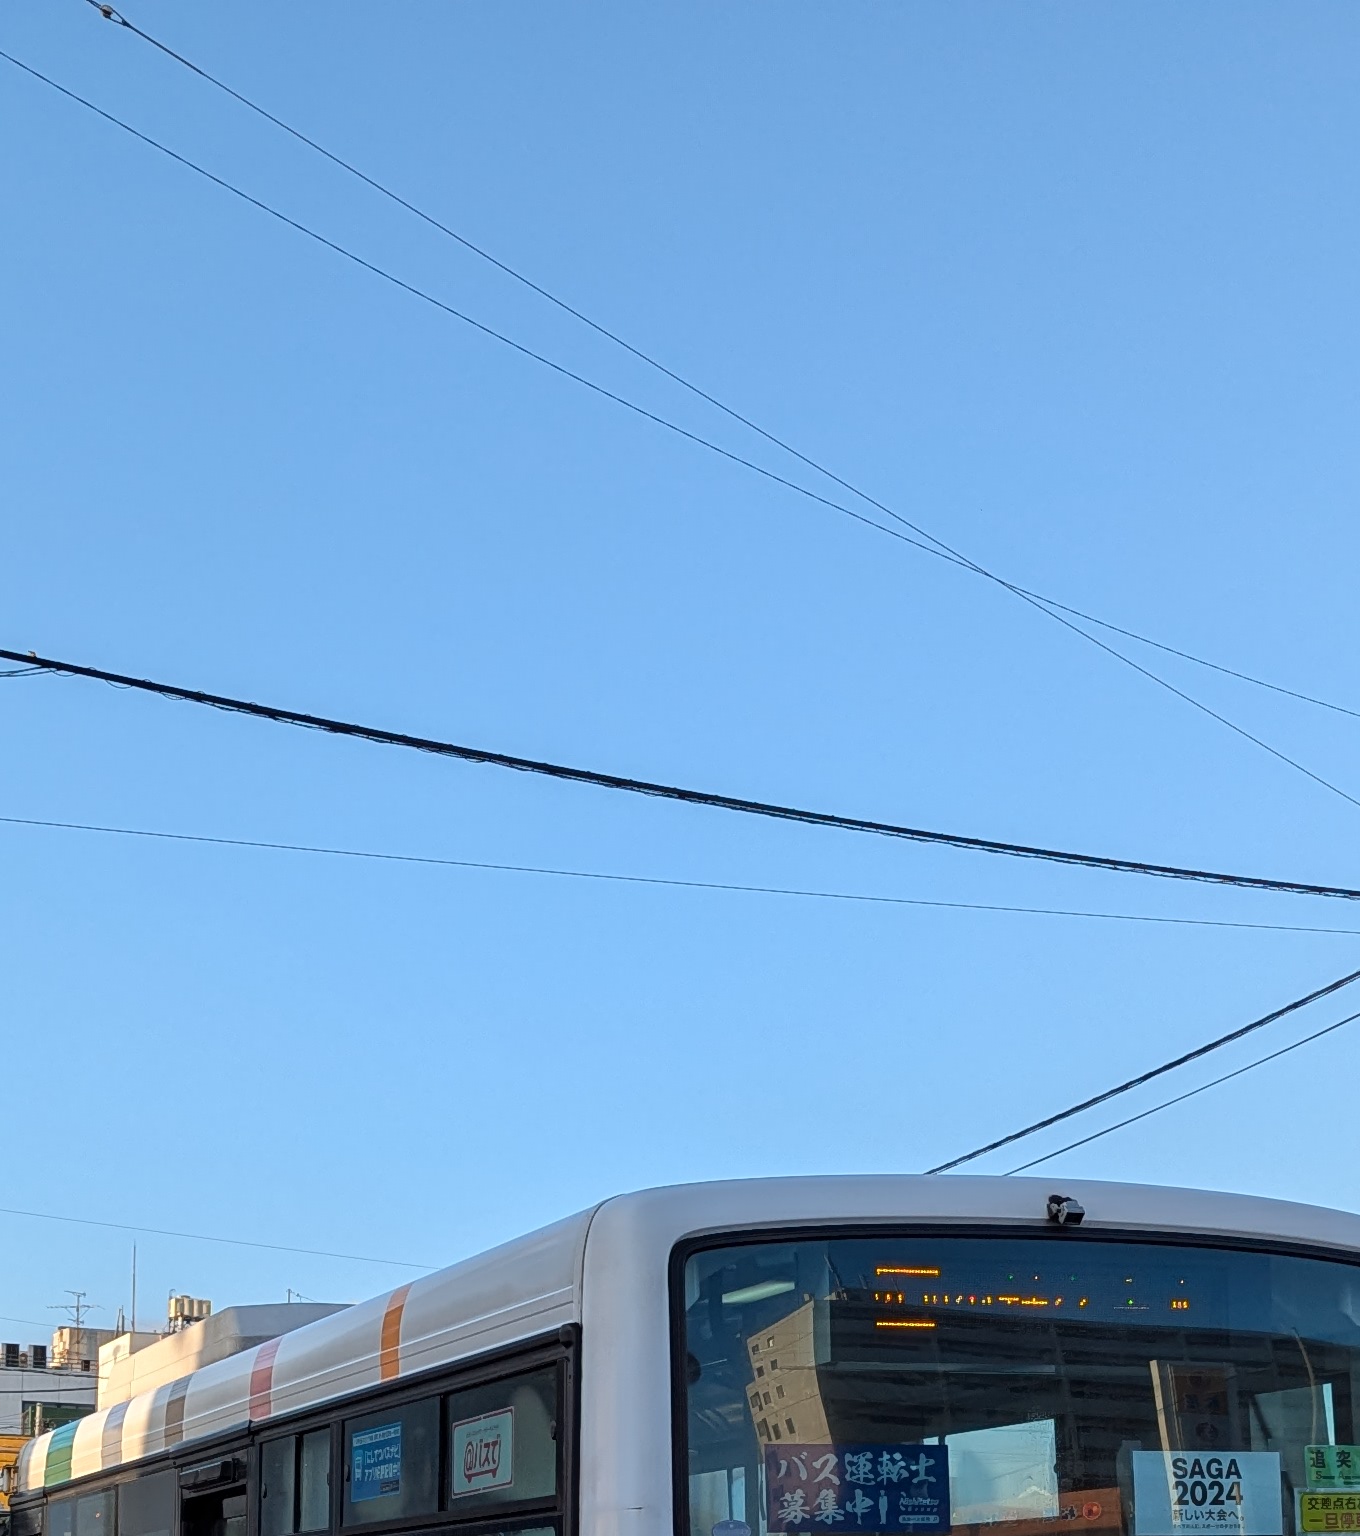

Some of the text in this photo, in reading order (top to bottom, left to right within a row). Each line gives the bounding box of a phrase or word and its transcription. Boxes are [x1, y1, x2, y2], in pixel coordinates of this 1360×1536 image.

[777, 1451, 937, 1485] バス運転士
[1172, 1458, 1242, 1479] SAGA
[1173, 1481, 1243, 1506] 2024
[777, 1488, 874, 1525] 募集中
[1173, 1509, 1244, 1521] 新しい大会へ。
